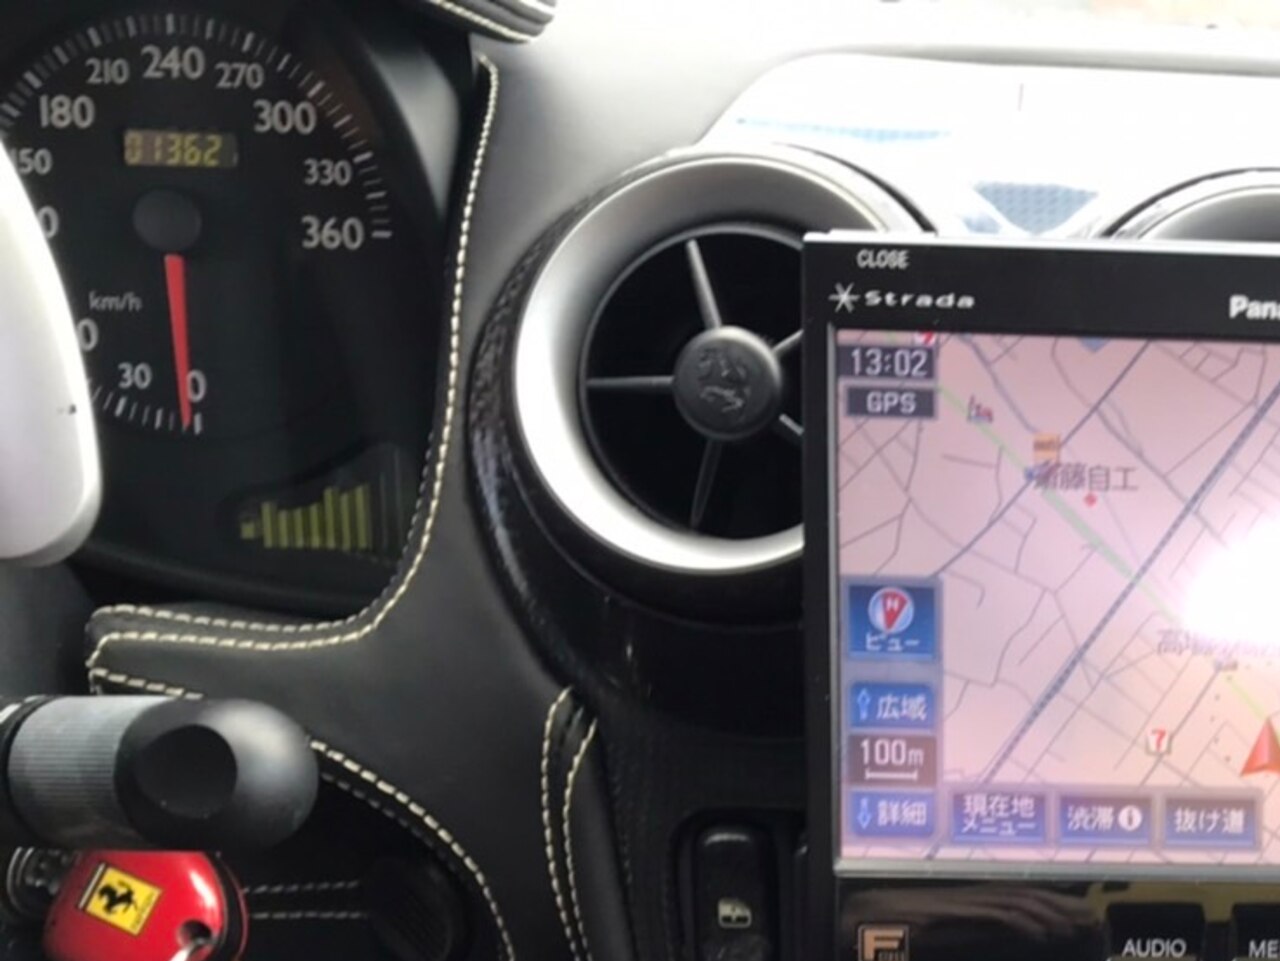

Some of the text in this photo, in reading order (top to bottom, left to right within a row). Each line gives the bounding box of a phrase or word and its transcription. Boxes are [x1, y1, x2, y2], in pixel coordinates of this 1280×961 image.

[85, 58, 130, 84] 210
[141, 46, 205, 79] 240
[215, 62, 264, 89] 270
[39, 95, 95, 128] 180
[253, 99, 317, 134] 300
[304, 160, 352, 186] 330
[302, 216, 364, 251] 360
[857, 250, 909, 269] CLOSE
[88, 291, 143, 312] km/h
[864, 289, 976, 308] Strada
[850, 347, 928, 377] 13:02
[118, 363, 152, 390] 30
[185, 370, 206, 402] 0
[866, 391, 917, 414] GPS
[865, 632, 920, 652] ビュー
[876, 693, 928, 721] 広域
[861, 739, 924, 766] 100m
[877, 801, 927, 827] 詳細
[963, 793, 1036, 818] 現在地
[1174, 807, 1245, 834] 抜け道
[1122, 938, 1187, 958] AUDIO
